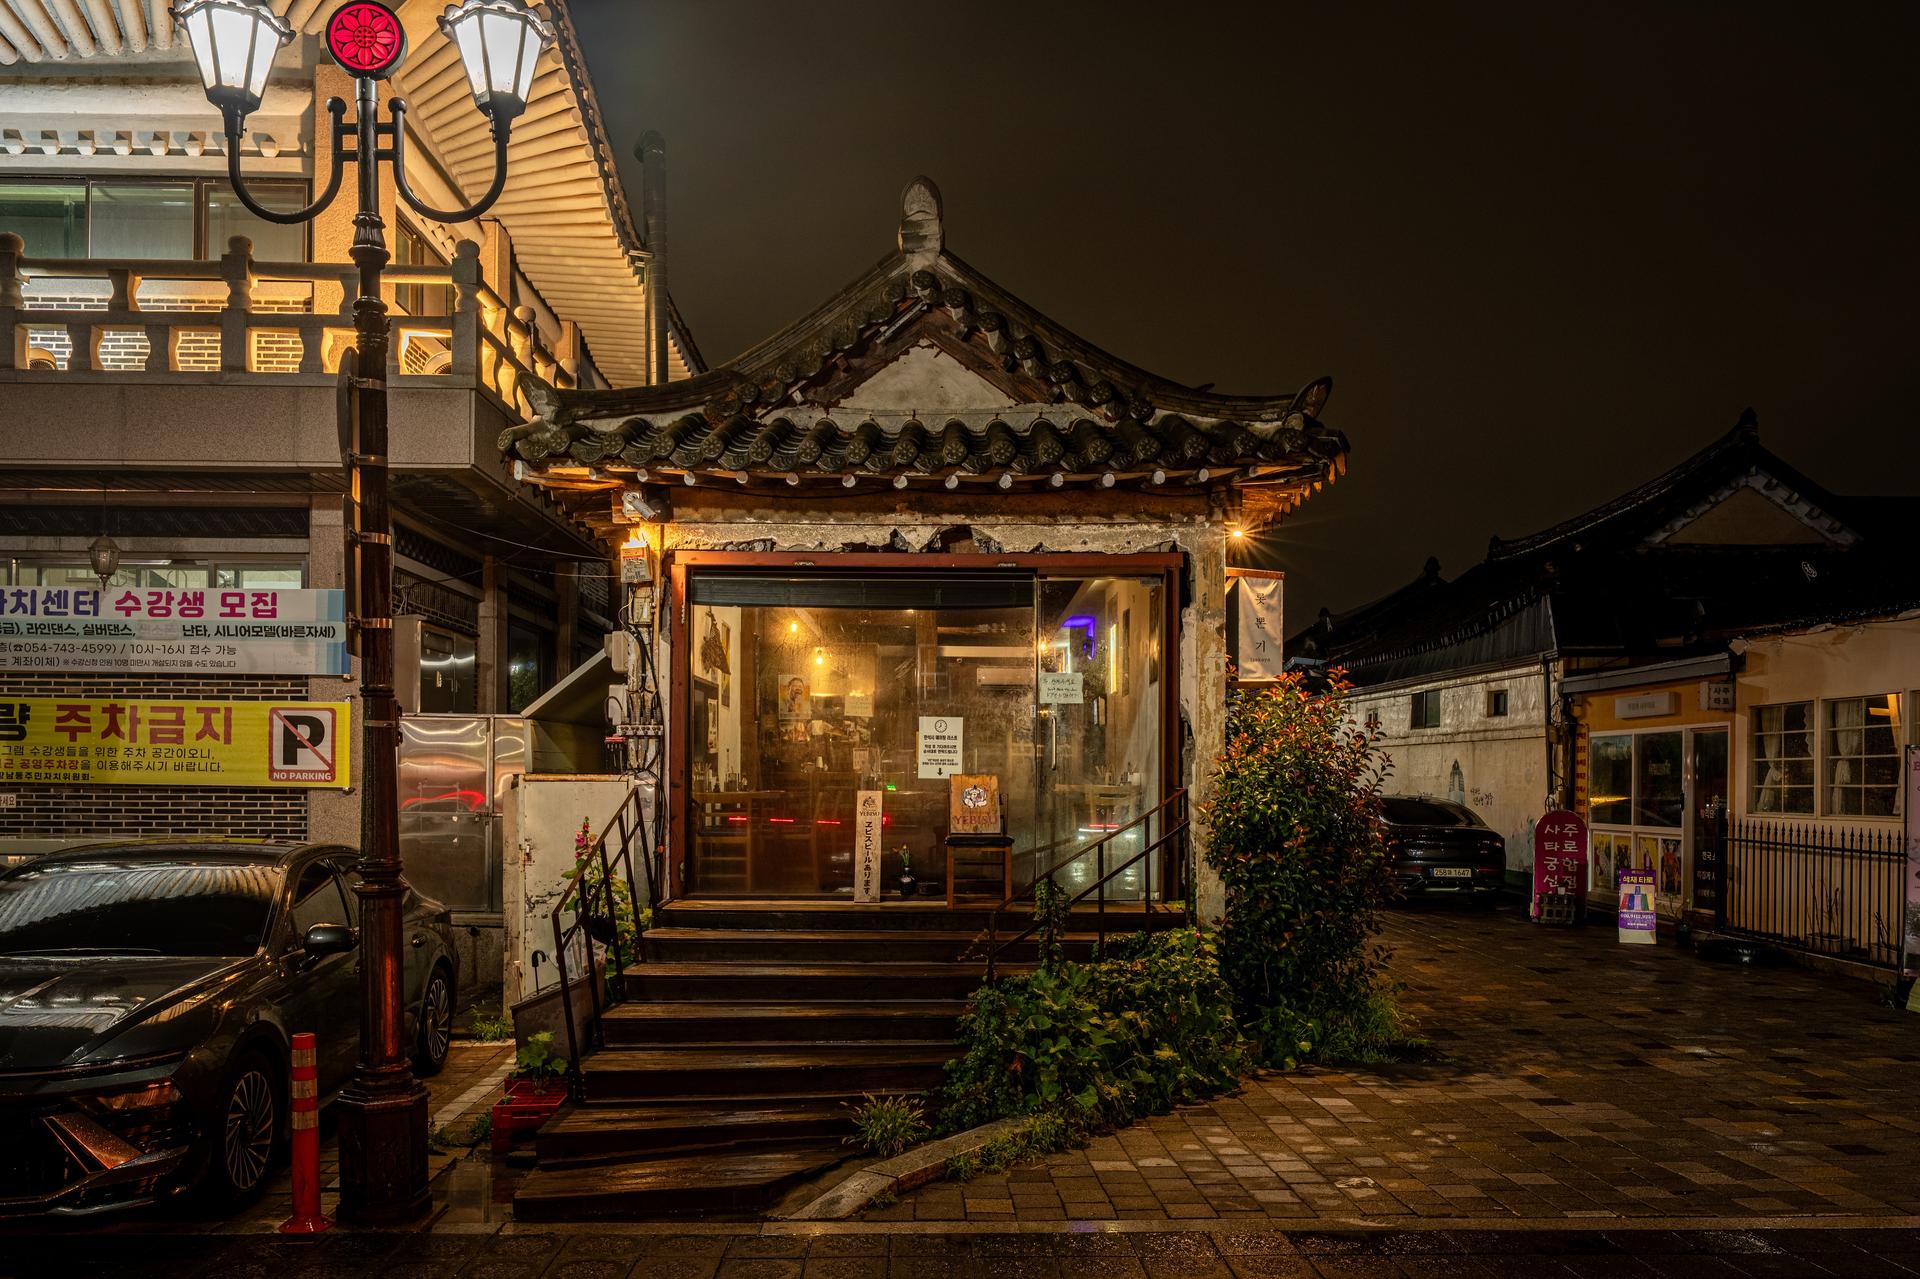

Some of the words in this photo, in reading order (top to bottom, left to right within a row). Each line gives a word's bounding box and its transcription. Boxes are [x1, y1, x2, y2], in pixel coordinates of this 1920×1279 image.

[0, 588, 99, 617] 치센터
[115, 590, 205, 618] 수강생
[219, 591, 278, 619] 모집
[0, 622, 23, 636] 급),
[26, 623, 80, 637] 라인댄스,
[83, 623, 136, 637] 실버댄스,
[182, 624, 211, 638] 난타,
[214, 625, 336, 639] 시니어모델(바른자세)
[130, 643, 185, 655] 10시~16시
[190, 645, 211, 655] 접수
[215, 645, 237, 655] 가능
[11, 656, 60, 667] 계좌이체)
[0, 703, 31, 741] 량
[54, 704, 233, 745] 주차금지
[30, 746, 89, 757] 수강생들을
[95, 747, 117, 758] 위한
[124, 748, 146, 758] 주차
[152, 748, 215, 760] 공간이오니,
[0, 758, 14, 770] 근
[20, 758, 91, 770] 공영주차장을
[97, 760, 168, 772] 이용해주시기
[174, 761, 225, 772] 바랍니다.
[273, 772, 287, 780] NO
[289, 772, 332, 781] PARKING
[0, 795, 15, 807] 세요
[954, 815, 998, 825] YEBISU
[1544, 823, 1579, 838] 사주
[1544, 840, 1579, 852] 타로
[1543, 856, 1579, 872] 궁합
